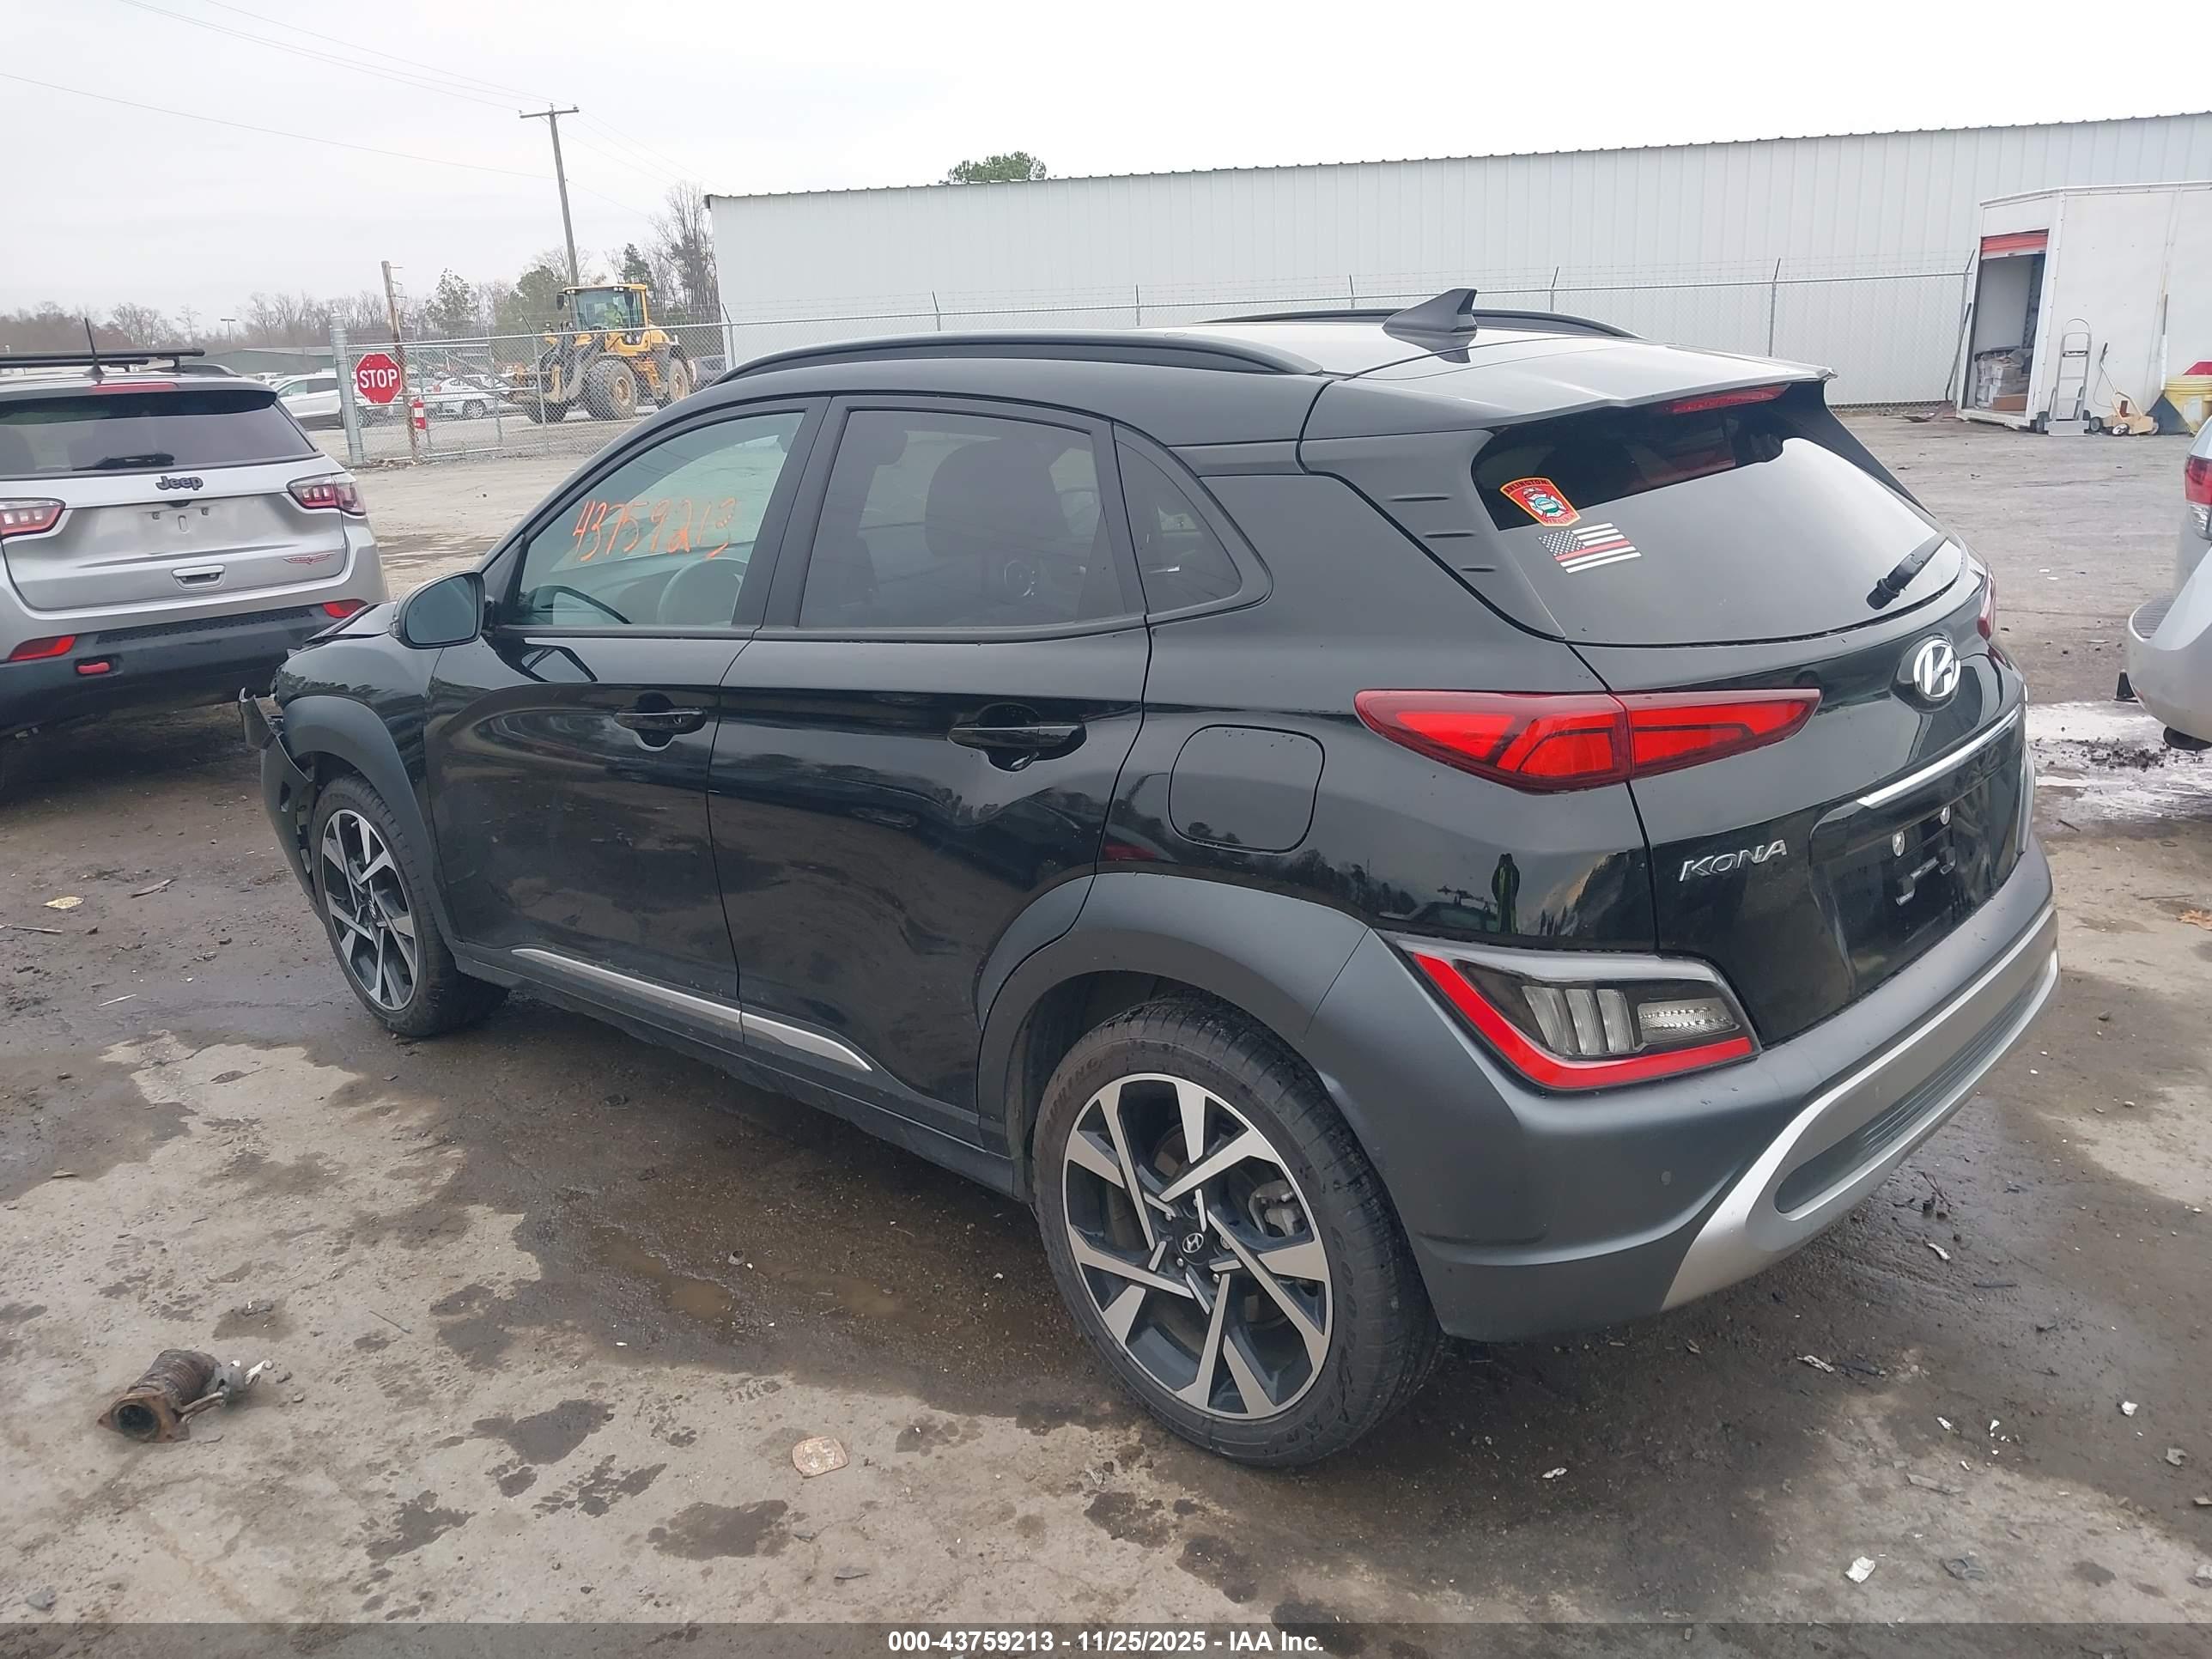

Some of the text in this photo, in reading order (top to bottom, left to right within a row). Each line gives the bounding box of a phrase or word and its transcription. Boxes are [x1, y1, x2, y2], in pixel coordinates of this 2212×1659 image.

[359, 368, 398, 389] STOP
[155, 476, 204, 490] Jeep
[1679, 839, 1787, 882] KONA
